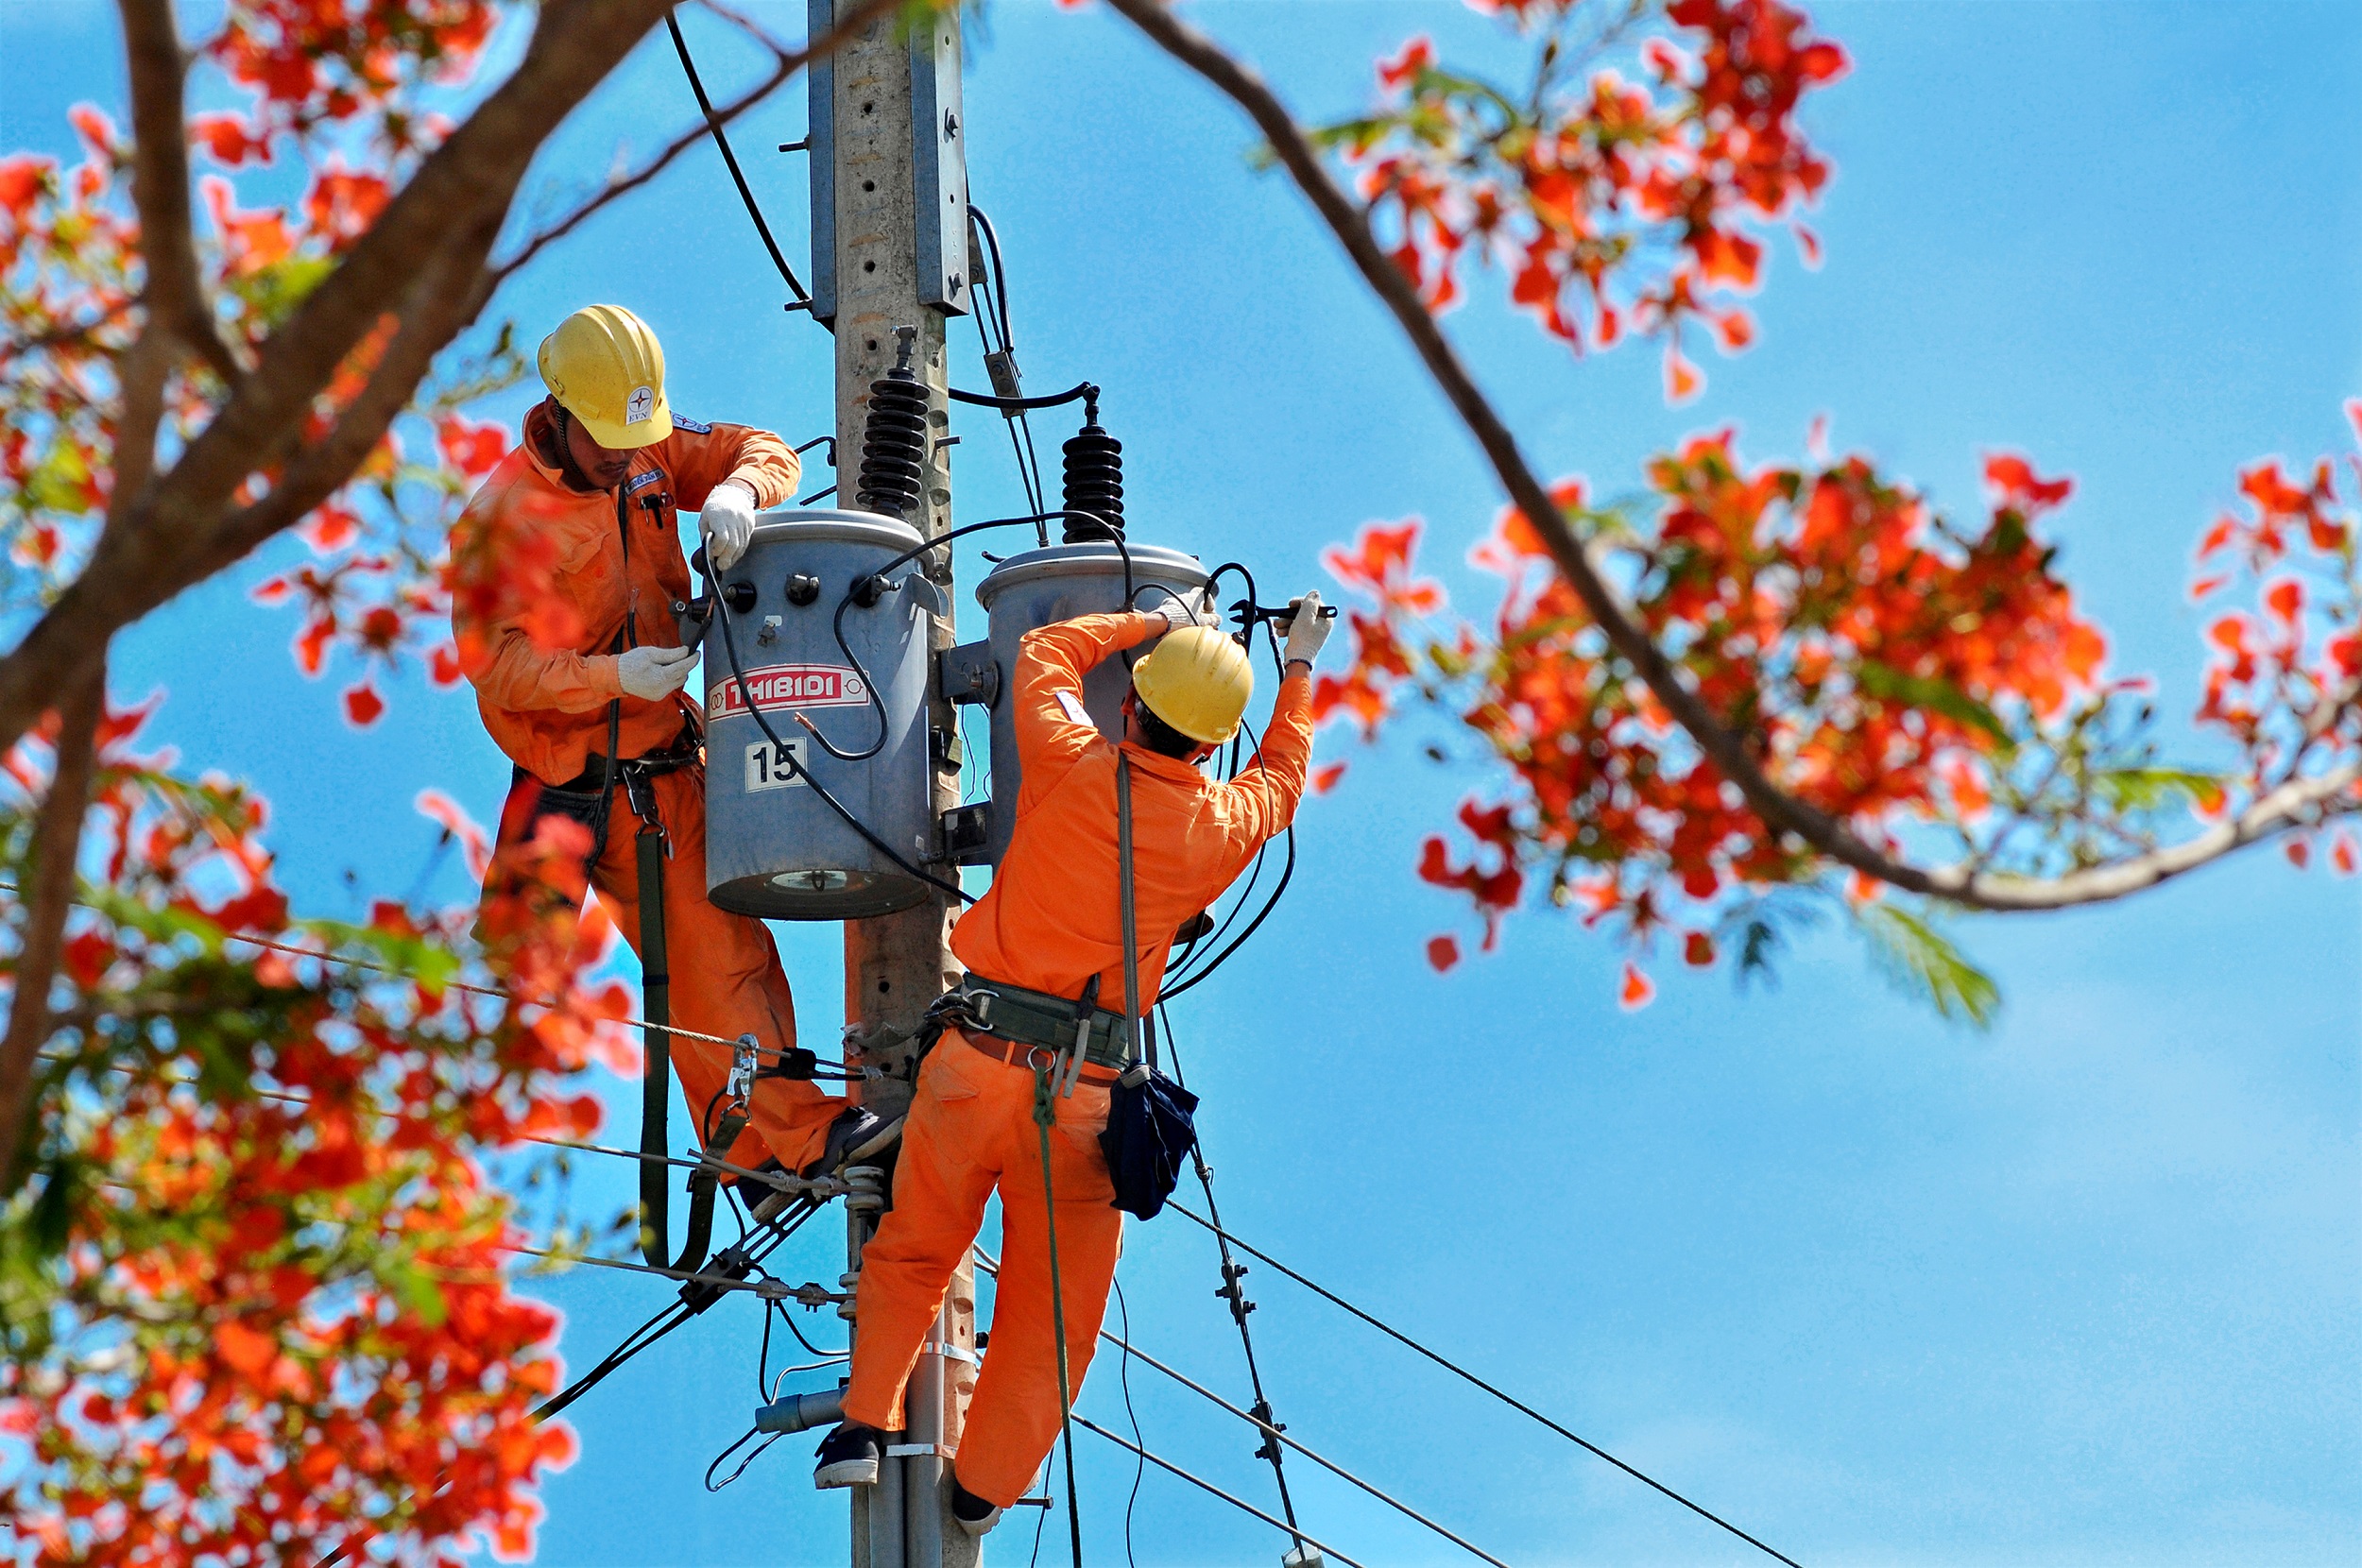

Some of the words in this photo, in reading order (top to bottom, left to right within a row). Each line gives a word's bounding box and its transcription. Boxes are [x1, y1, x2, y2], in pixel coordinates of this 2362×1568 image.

[628, 412, 648, 422] EVN
[730, 675, 833, 705] THIBIDI
[752, 744, 797, 782] 15
